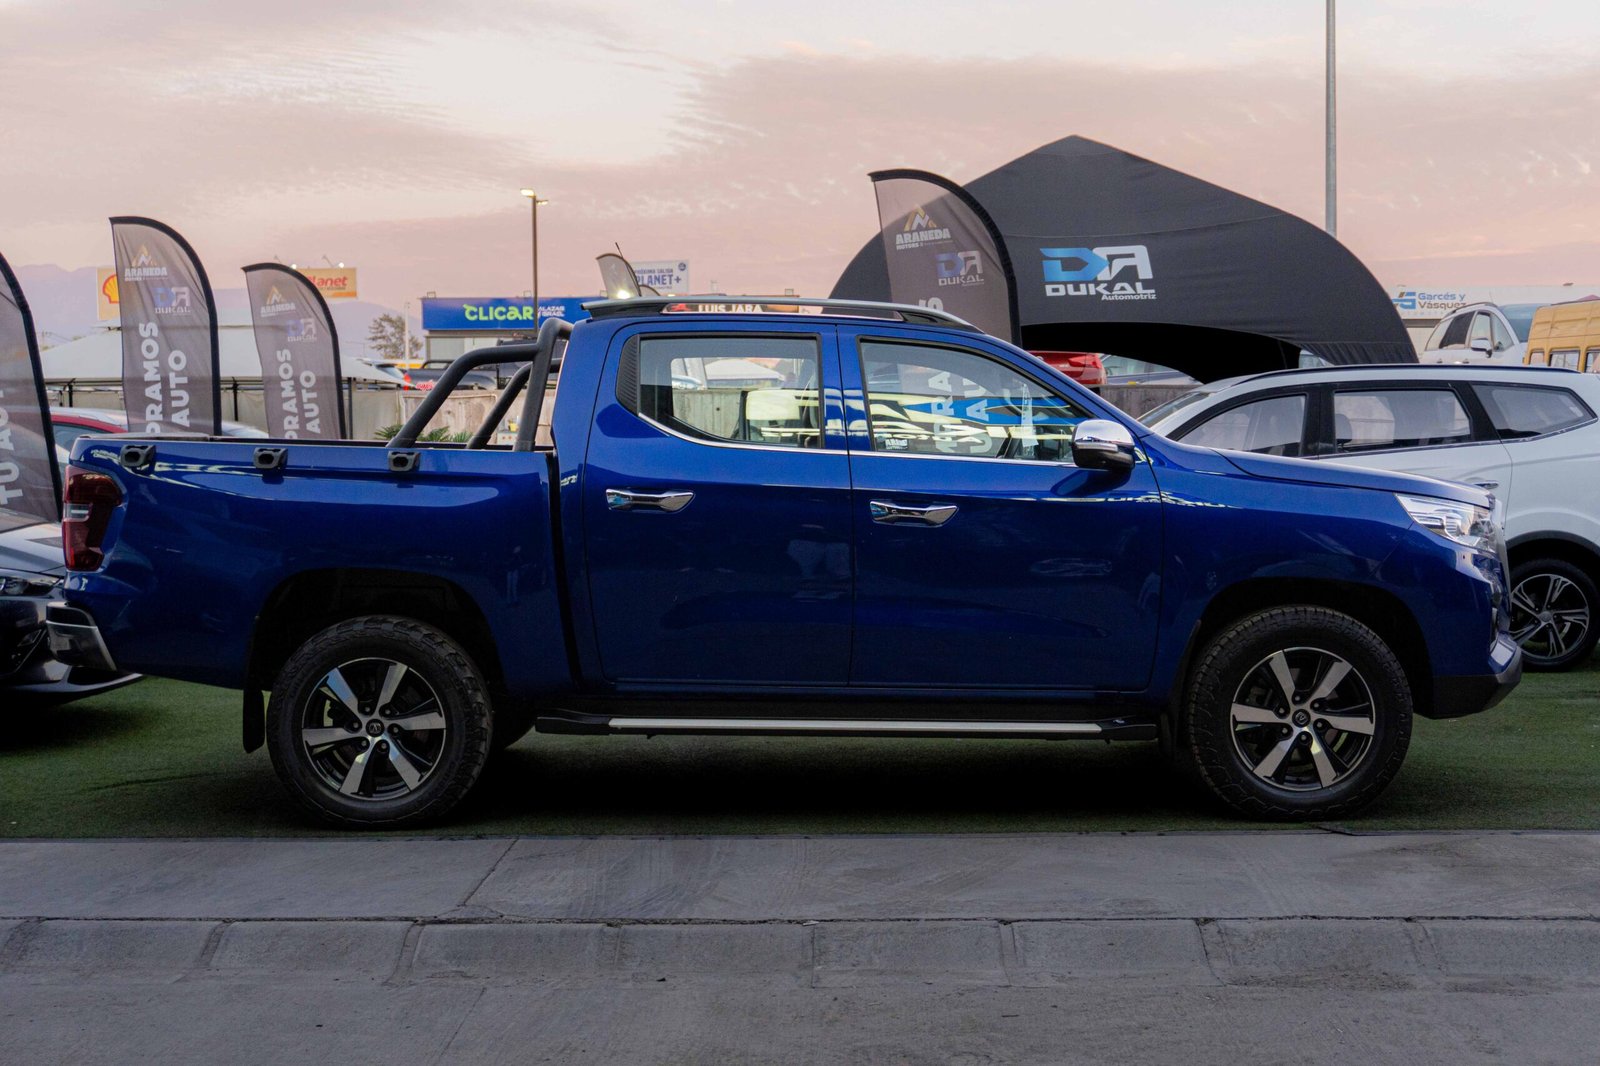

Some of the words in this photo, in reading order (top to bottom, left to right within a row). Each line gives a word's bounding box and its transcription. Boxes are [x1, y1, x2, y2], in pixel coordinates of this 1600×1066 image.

[896, 228, 951, 245] ARANEDA
[938, 274, 985, 287] DUKAL
[1045, 282, 1156, 297] DUKAL
[1101, 293, 1157, 301] Automotriz
[1459, 293, 1466, 301] y
[698, 303, 726, 313] LUIS
[729, 303, 763, 313] JARA
[168, 350, 190, 427] AUTO
[300, 370, 321, 434] AUTO
